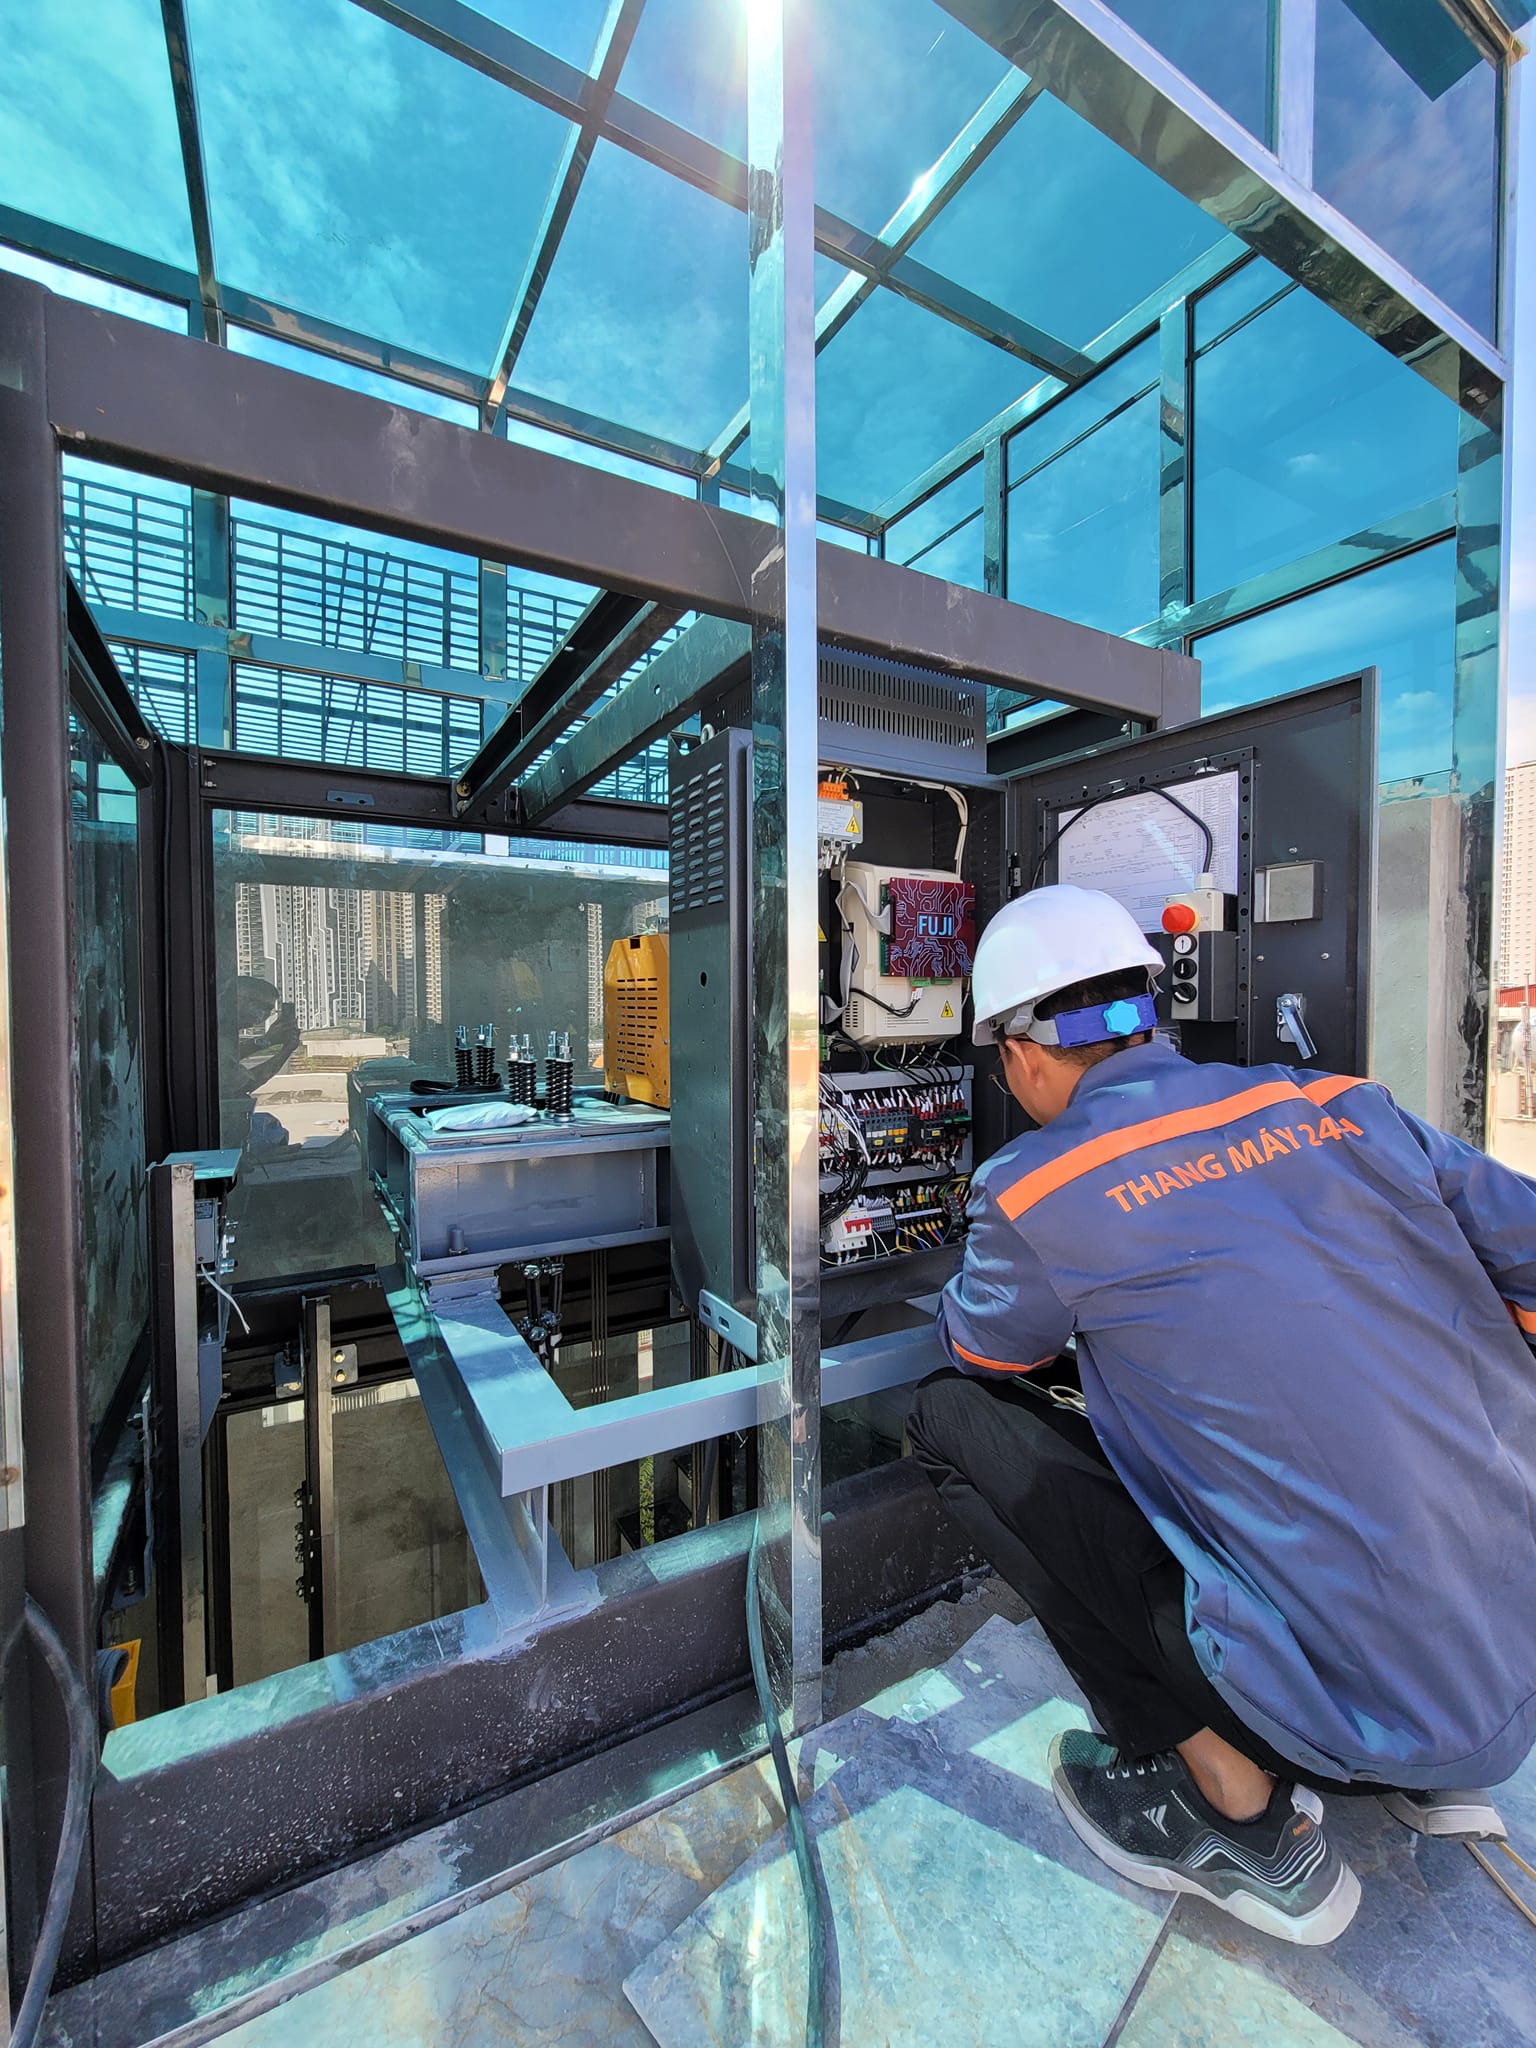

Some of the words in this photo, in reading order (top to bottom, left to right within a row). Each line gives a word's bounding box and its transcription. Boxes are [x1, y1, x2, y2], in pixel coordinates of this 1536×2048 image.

[918, 915, 953, 936] FUJI
[1105, 1153, 1227, 1213] THANG
[1227, 1127, 1301, 1173] MÁY
